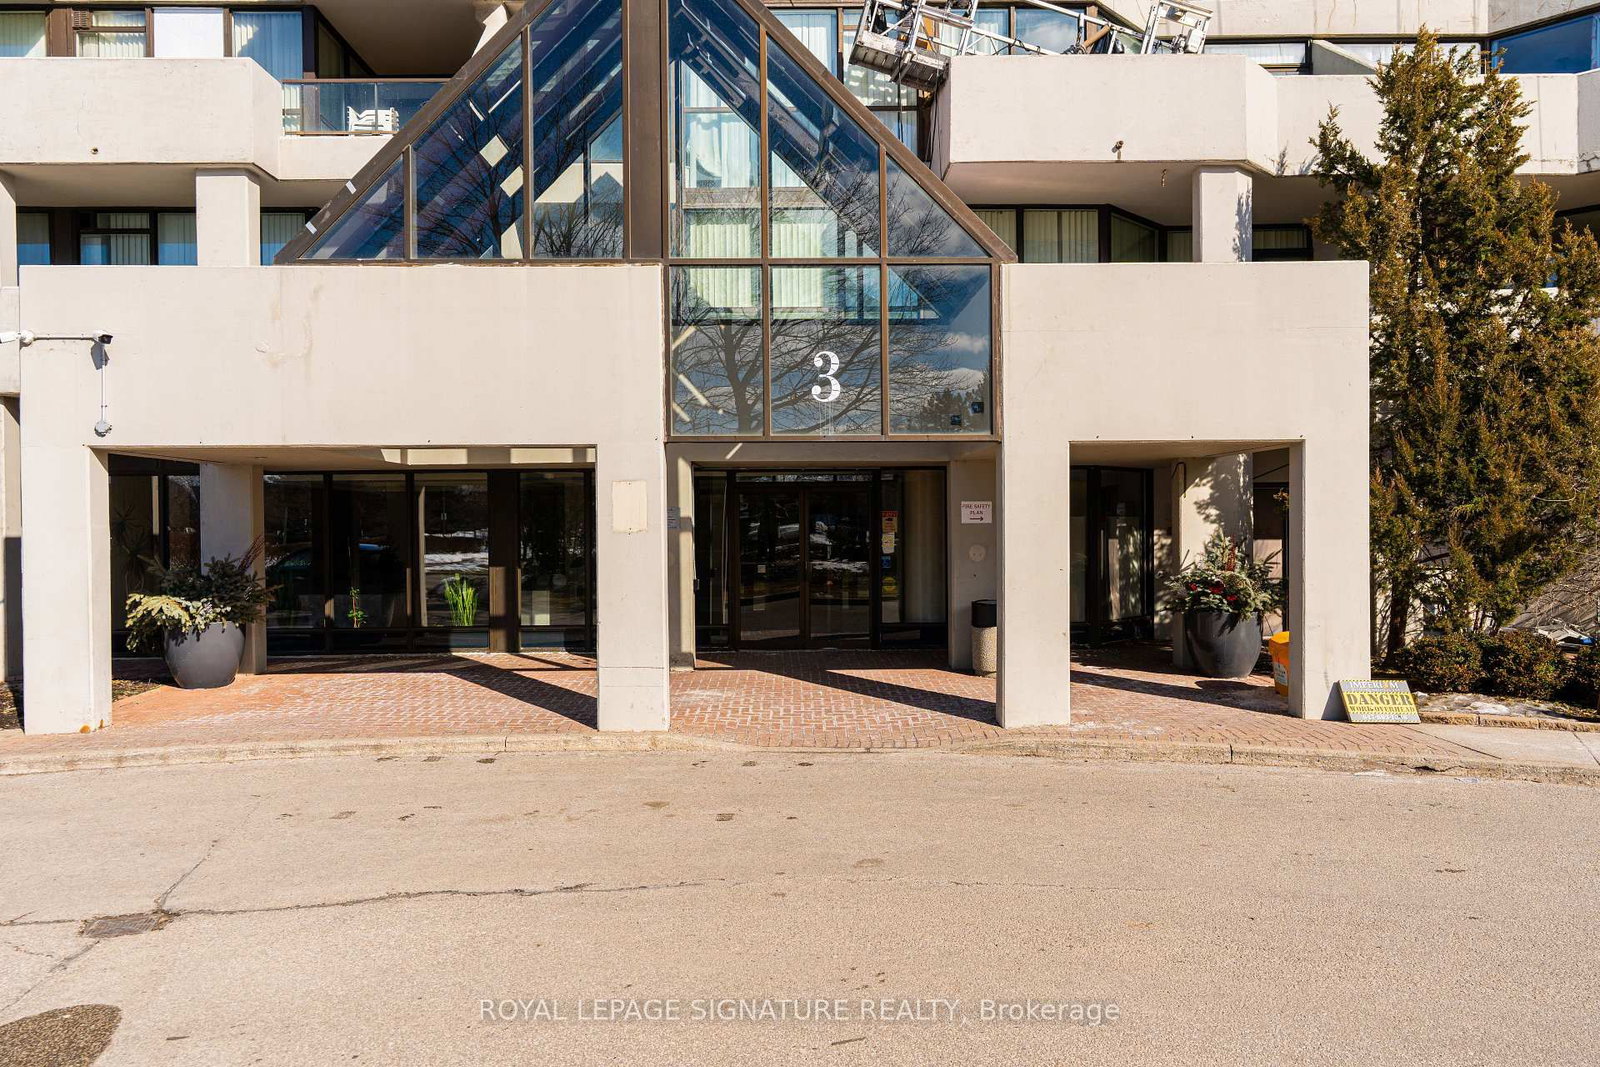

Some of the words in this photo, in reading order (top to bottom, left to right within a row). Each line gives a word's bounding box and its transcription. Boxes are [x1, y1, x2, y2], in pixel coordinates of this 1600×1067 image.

[811, 351, 840, 402] 3
[1346, 693, 1412, 705] DANGER
[1375, 705, 1415, 713] OVERHEAD
